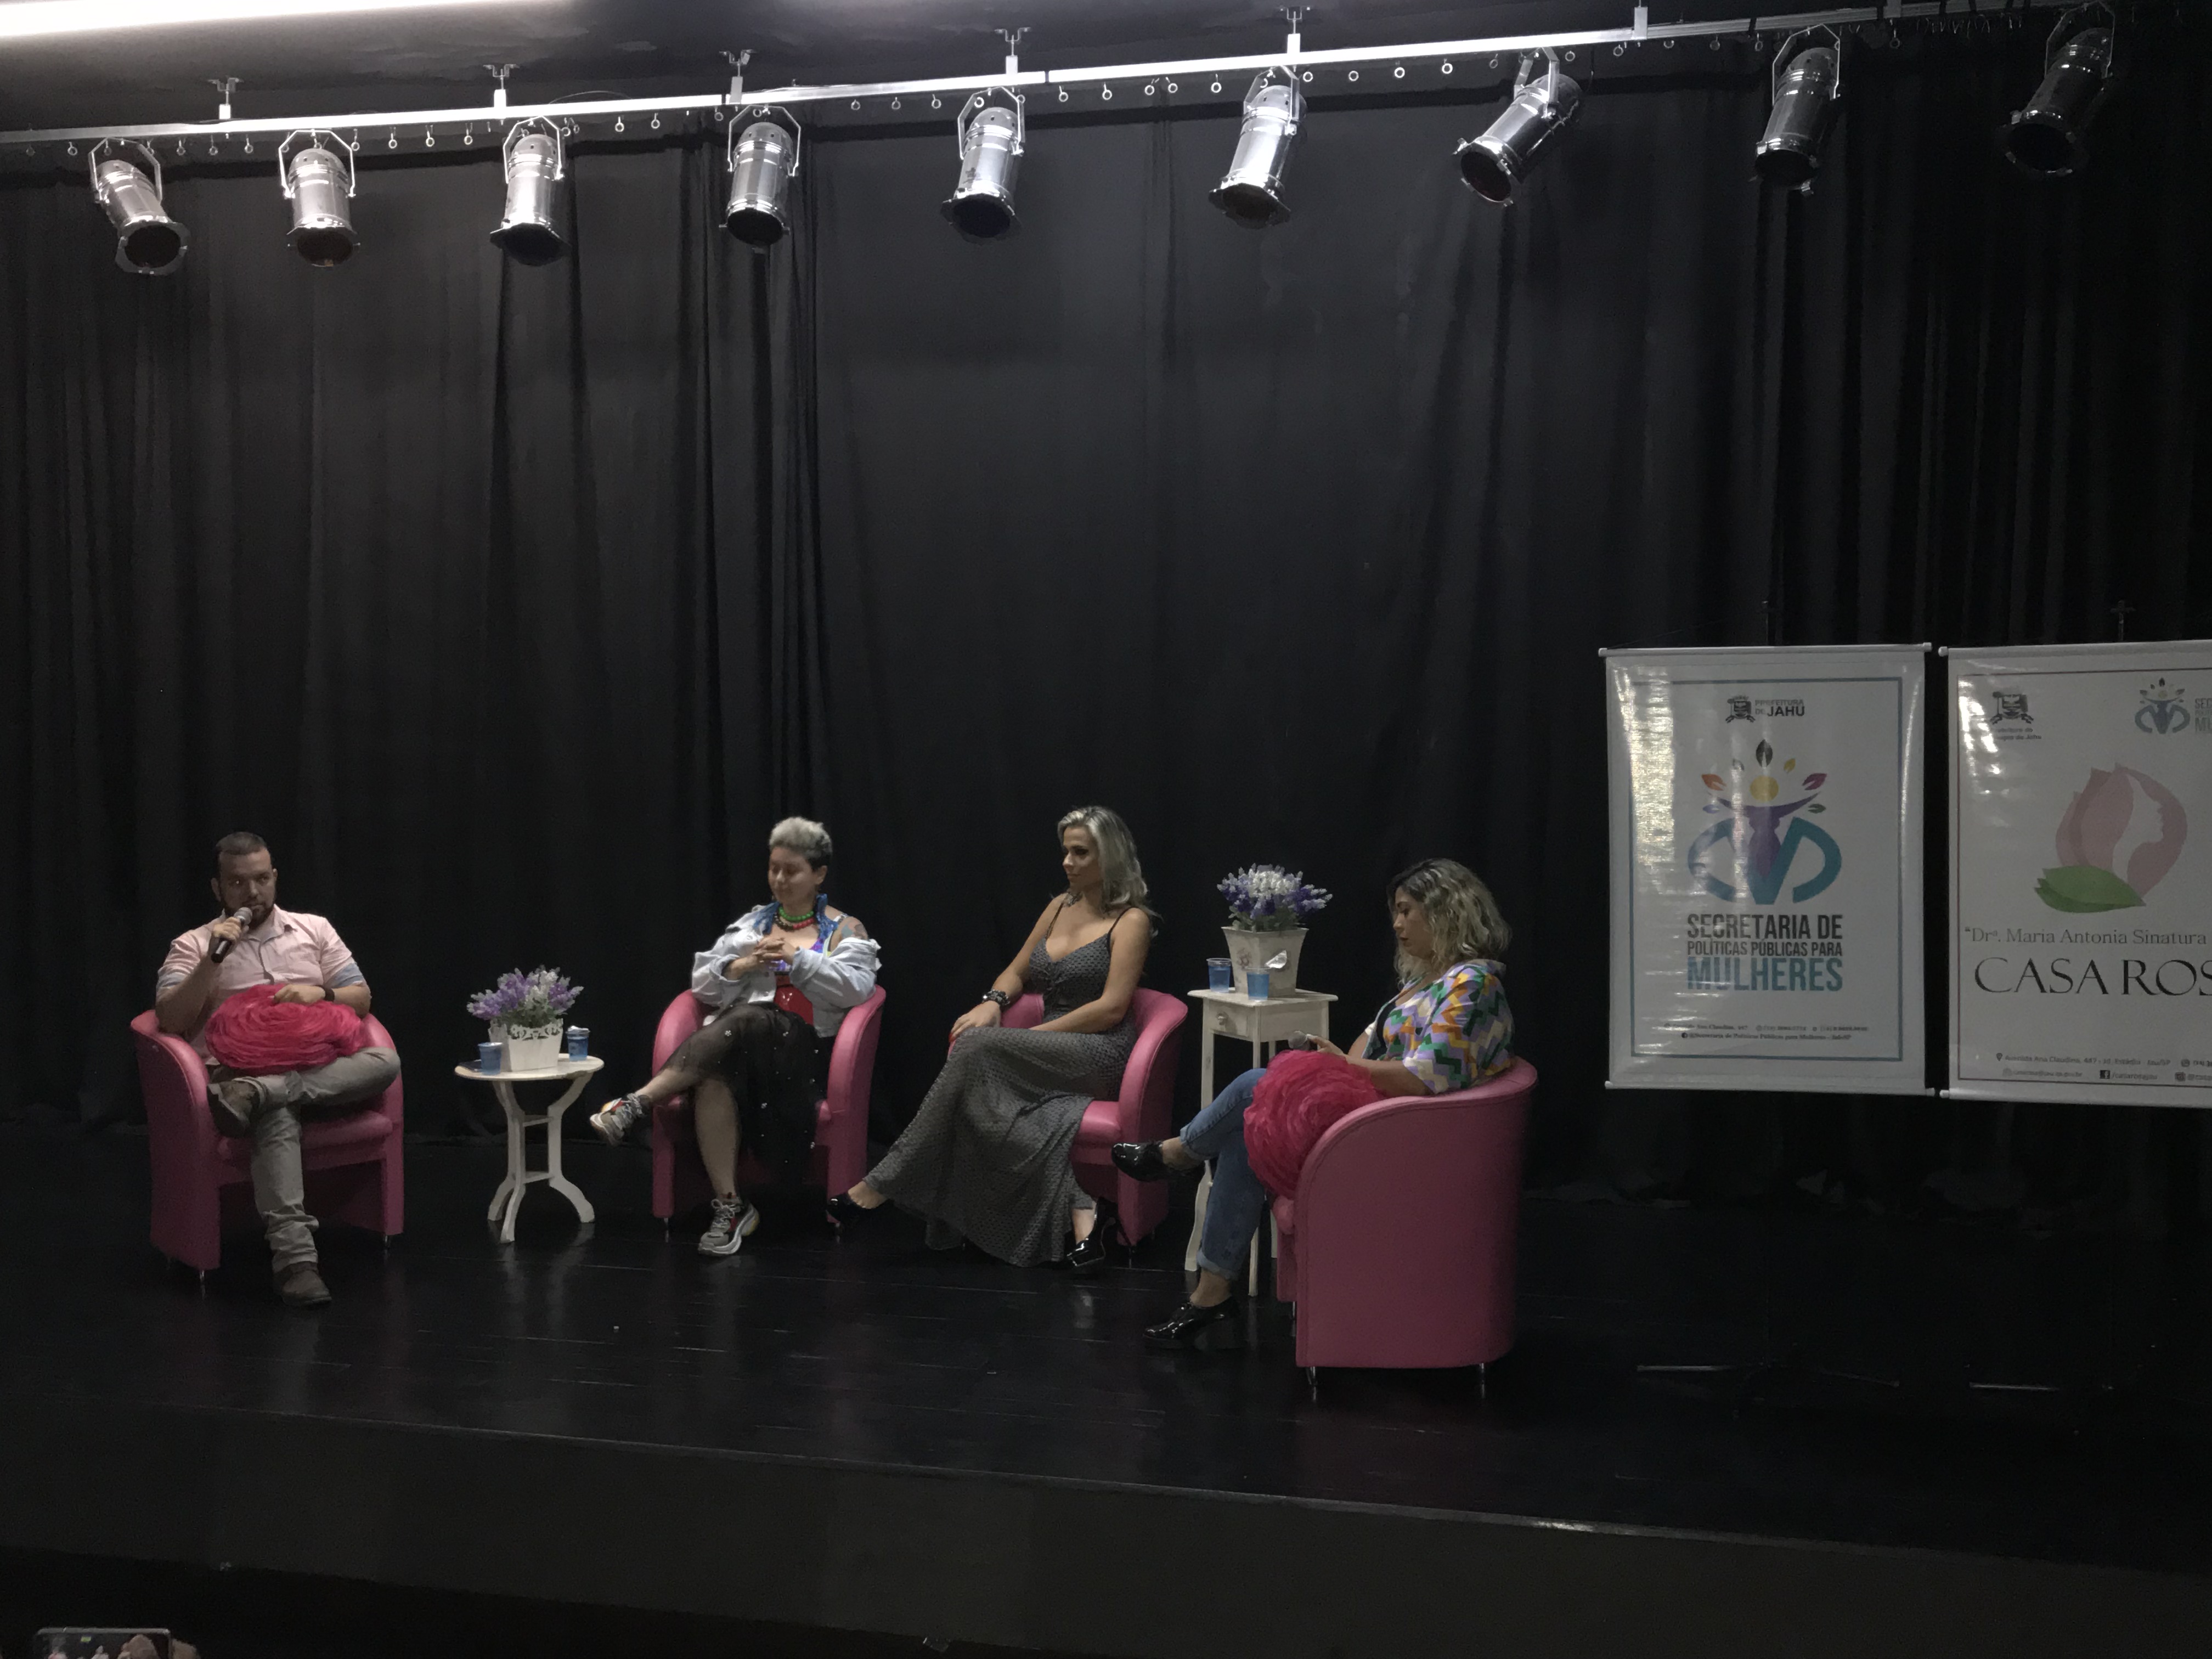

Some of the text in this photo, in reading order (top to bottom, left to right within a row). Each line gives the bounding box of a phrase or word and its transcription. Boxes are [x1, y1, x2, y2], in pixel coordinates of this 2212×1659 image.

[1767, 706, 1805, 716] JAHU
[1687, 913, 1843, 939] SECRETARIA DE
[2006, 928, 2055, 944] Maria
[2059, 929, 2128, 944] Antonia
[2133, 929, 2207, 945] Sinatura
[1687, 938, 1843, 957] POLÍTICAS PÚBLICAS PARA
[1687, 956, 1843, 991] MULHERES
[1975, 957, 2109, 995] CASA
